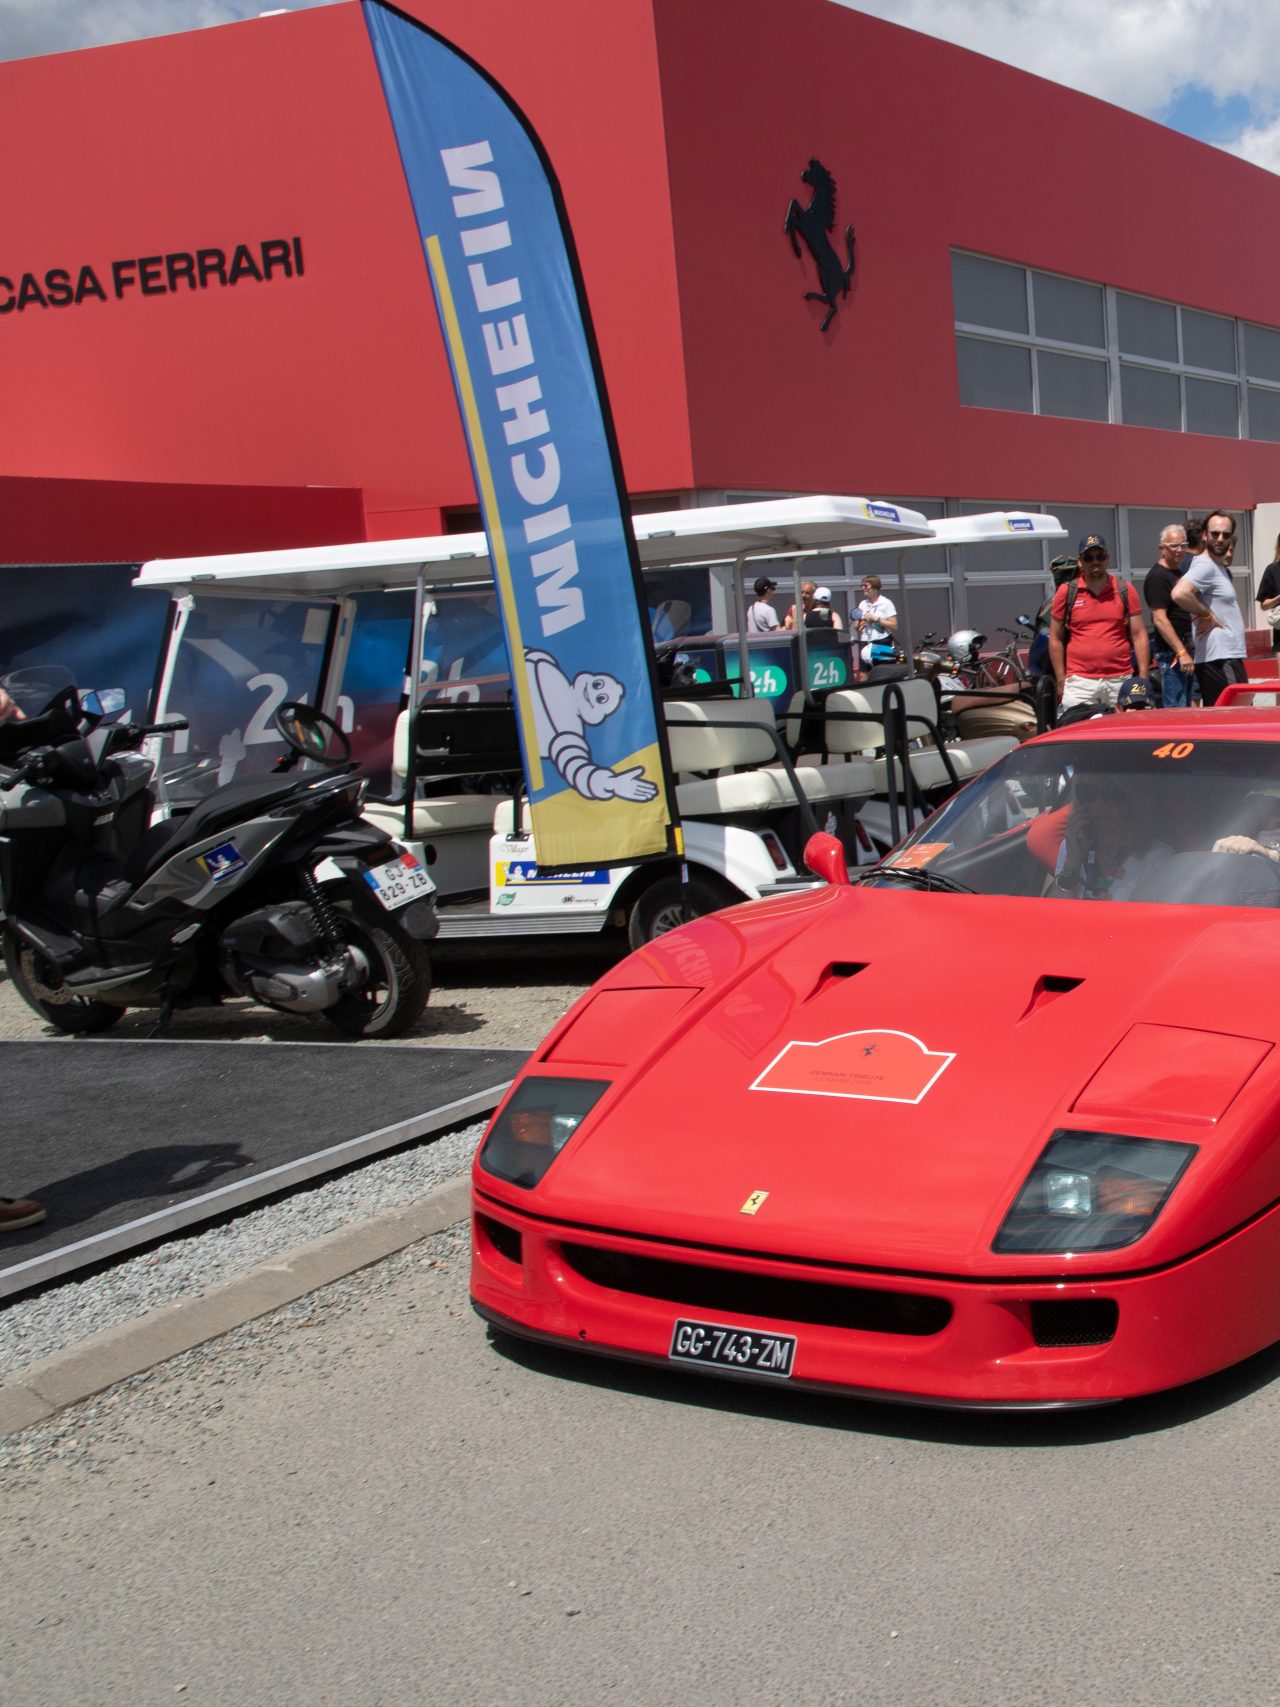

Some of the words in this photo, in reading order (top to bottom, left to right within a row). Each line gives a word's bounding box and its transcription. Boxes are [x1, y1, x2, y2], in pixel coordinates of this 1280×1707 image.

[0, 265, 107, 315] CASA
[111, 236, 304, 300] FERRARI
[440, 140, 586, 638] MICHELIN
[813, 661, 840, 686] 24h
[1152, 743, 1194, 759] 40
[379, 873, 427, 901] 829-ZB
[676, 1325, 790, 1370] GG-743-ZM
